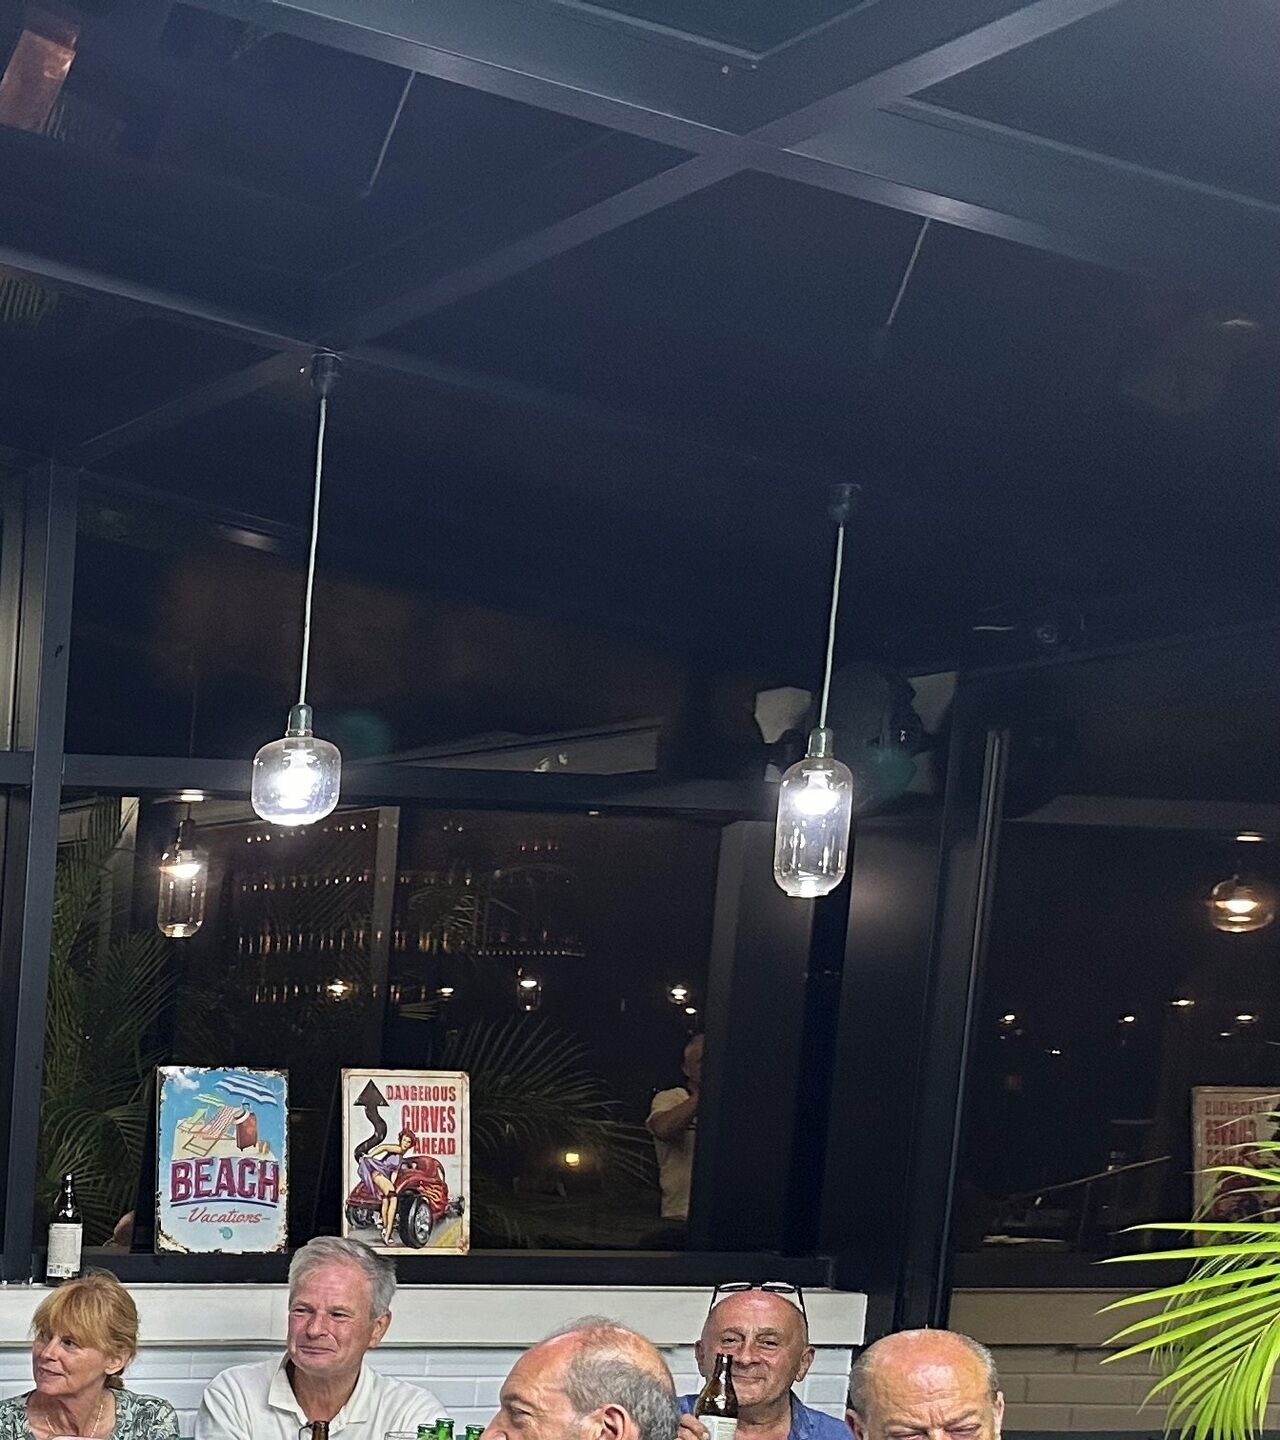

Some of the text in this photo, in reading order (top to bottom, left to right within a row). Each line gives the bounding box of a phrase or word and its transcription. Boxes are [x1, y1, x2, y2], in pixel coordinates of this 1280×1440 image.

[385, 1084, 457, 1102] DANGEROUS
[401, 1104, 457, 1134] CURVES
[411, 1137, 457, 1155] AHEAD
[170, 1156, 280, 1202] BEACH
[187, 1207, 263, 1225] Vacations
